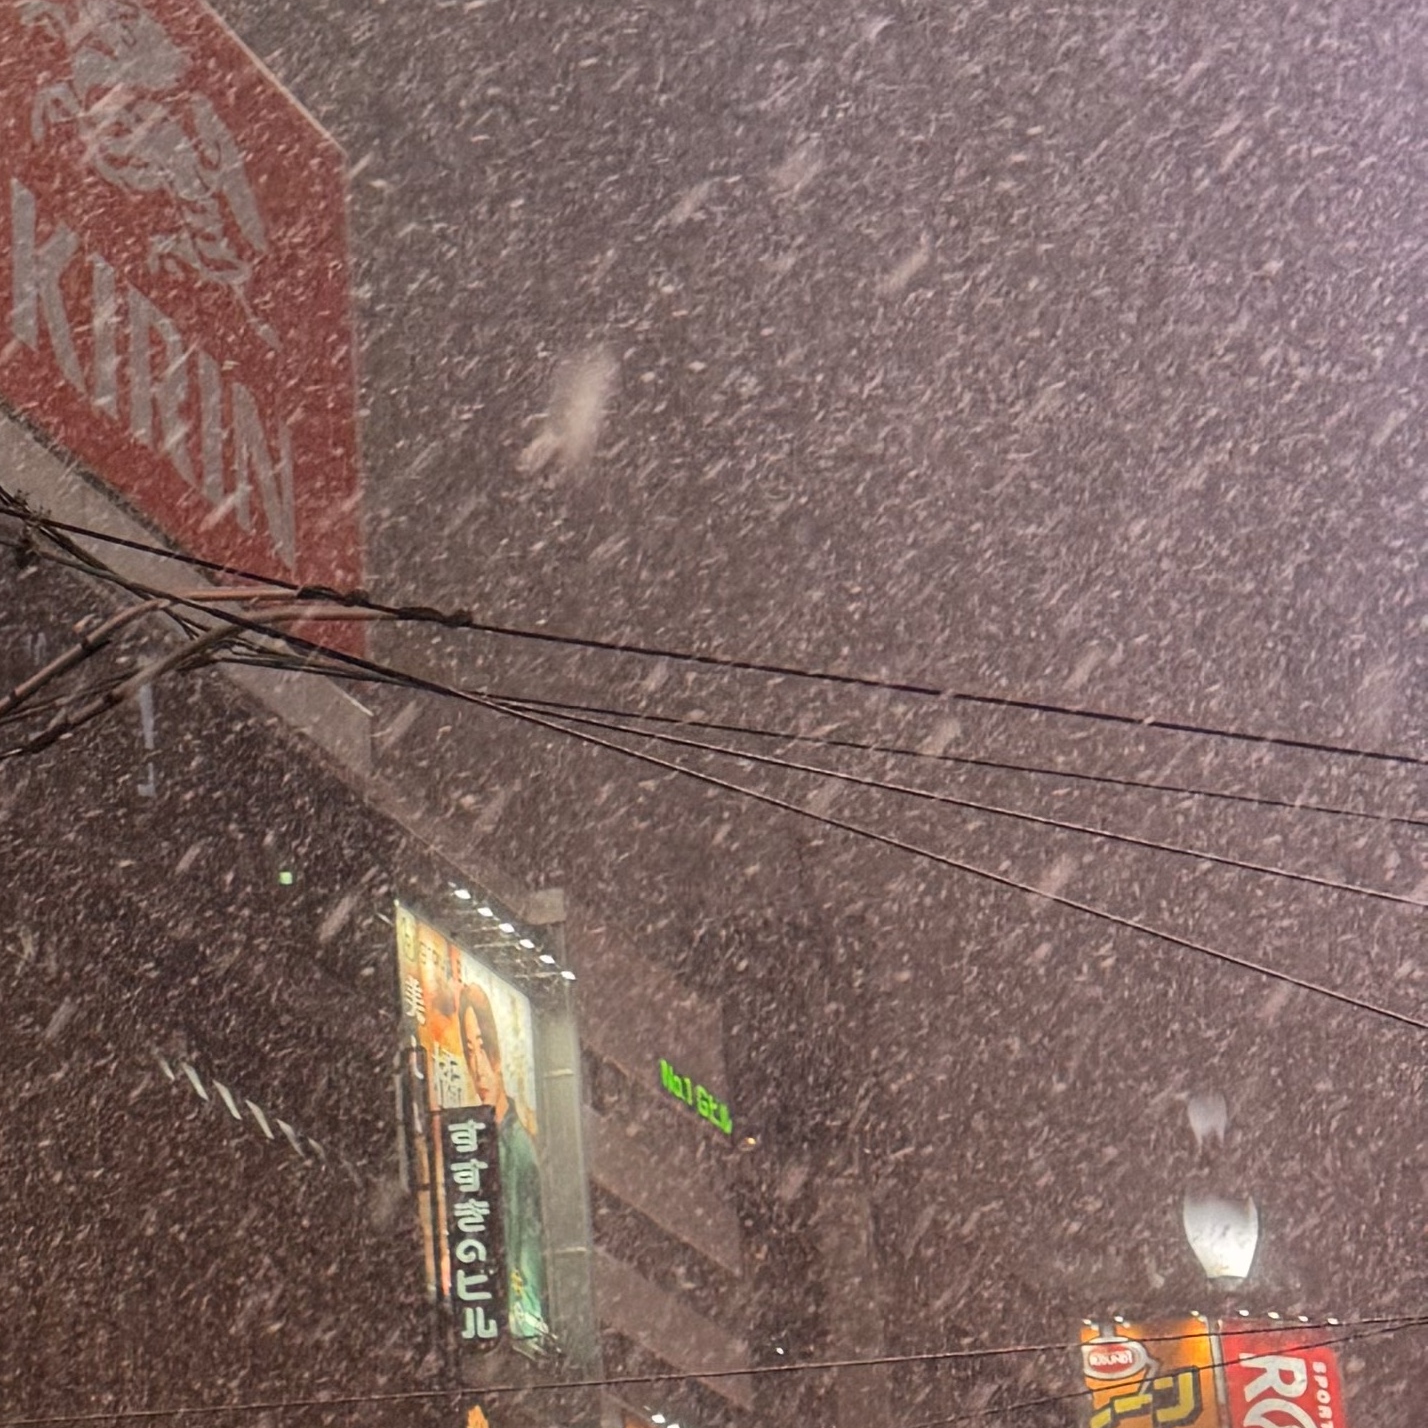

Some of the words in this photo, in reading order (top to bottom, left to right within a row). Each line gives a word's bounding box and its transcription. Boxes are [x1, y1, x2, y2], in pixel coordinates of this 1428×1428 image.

[9, 174, 300, 572] KIRIN
[447, 1118, 499, 1340] すすきのビル
